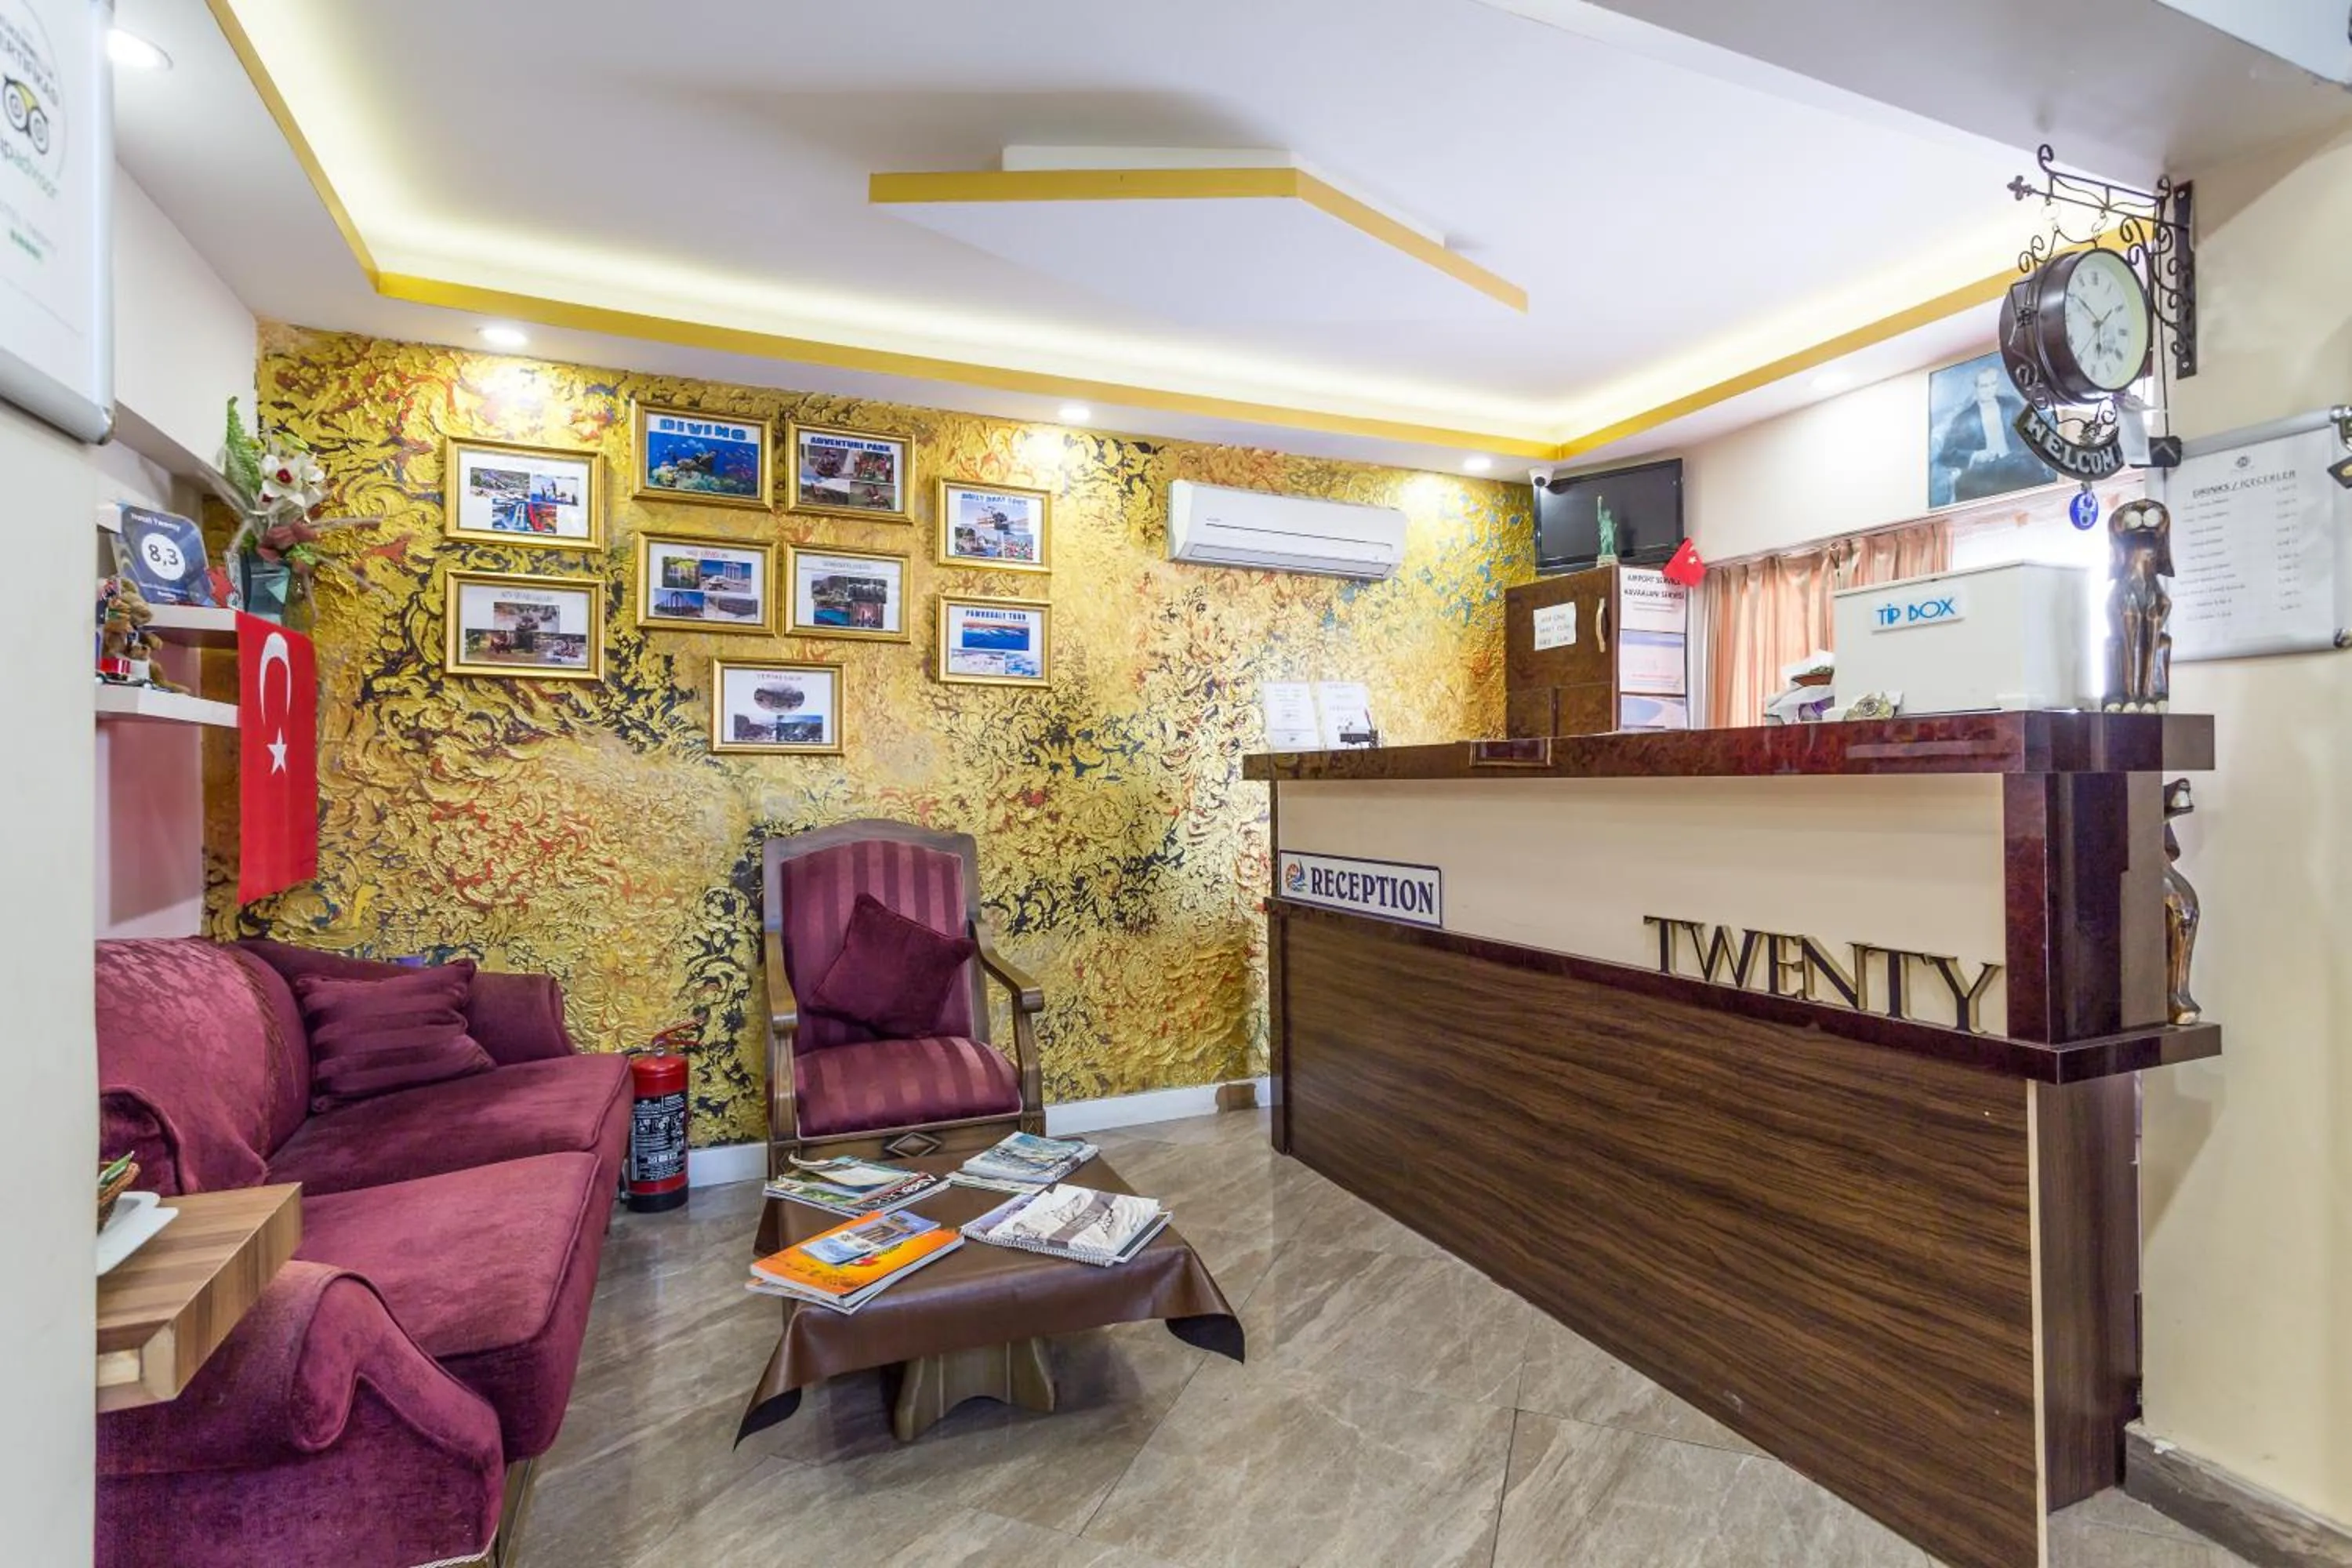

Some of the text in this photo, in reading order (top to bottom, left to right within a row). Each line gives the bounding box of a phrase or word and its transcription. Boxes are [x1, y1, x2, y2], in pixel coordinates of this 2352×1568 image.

[659, 418, 746, 441] DIVING
[810, 436, 891, 452] ADVENTURE PARK
[2026, 412, 2122, 474] WELCOM
[148, 543, 179, 567] 8,3
[1907, 597, 1955, 622] BOX
[1310, 866, 1434, 915] RECEPTION
[1642, 914, 2004, 1035] TWENTY
